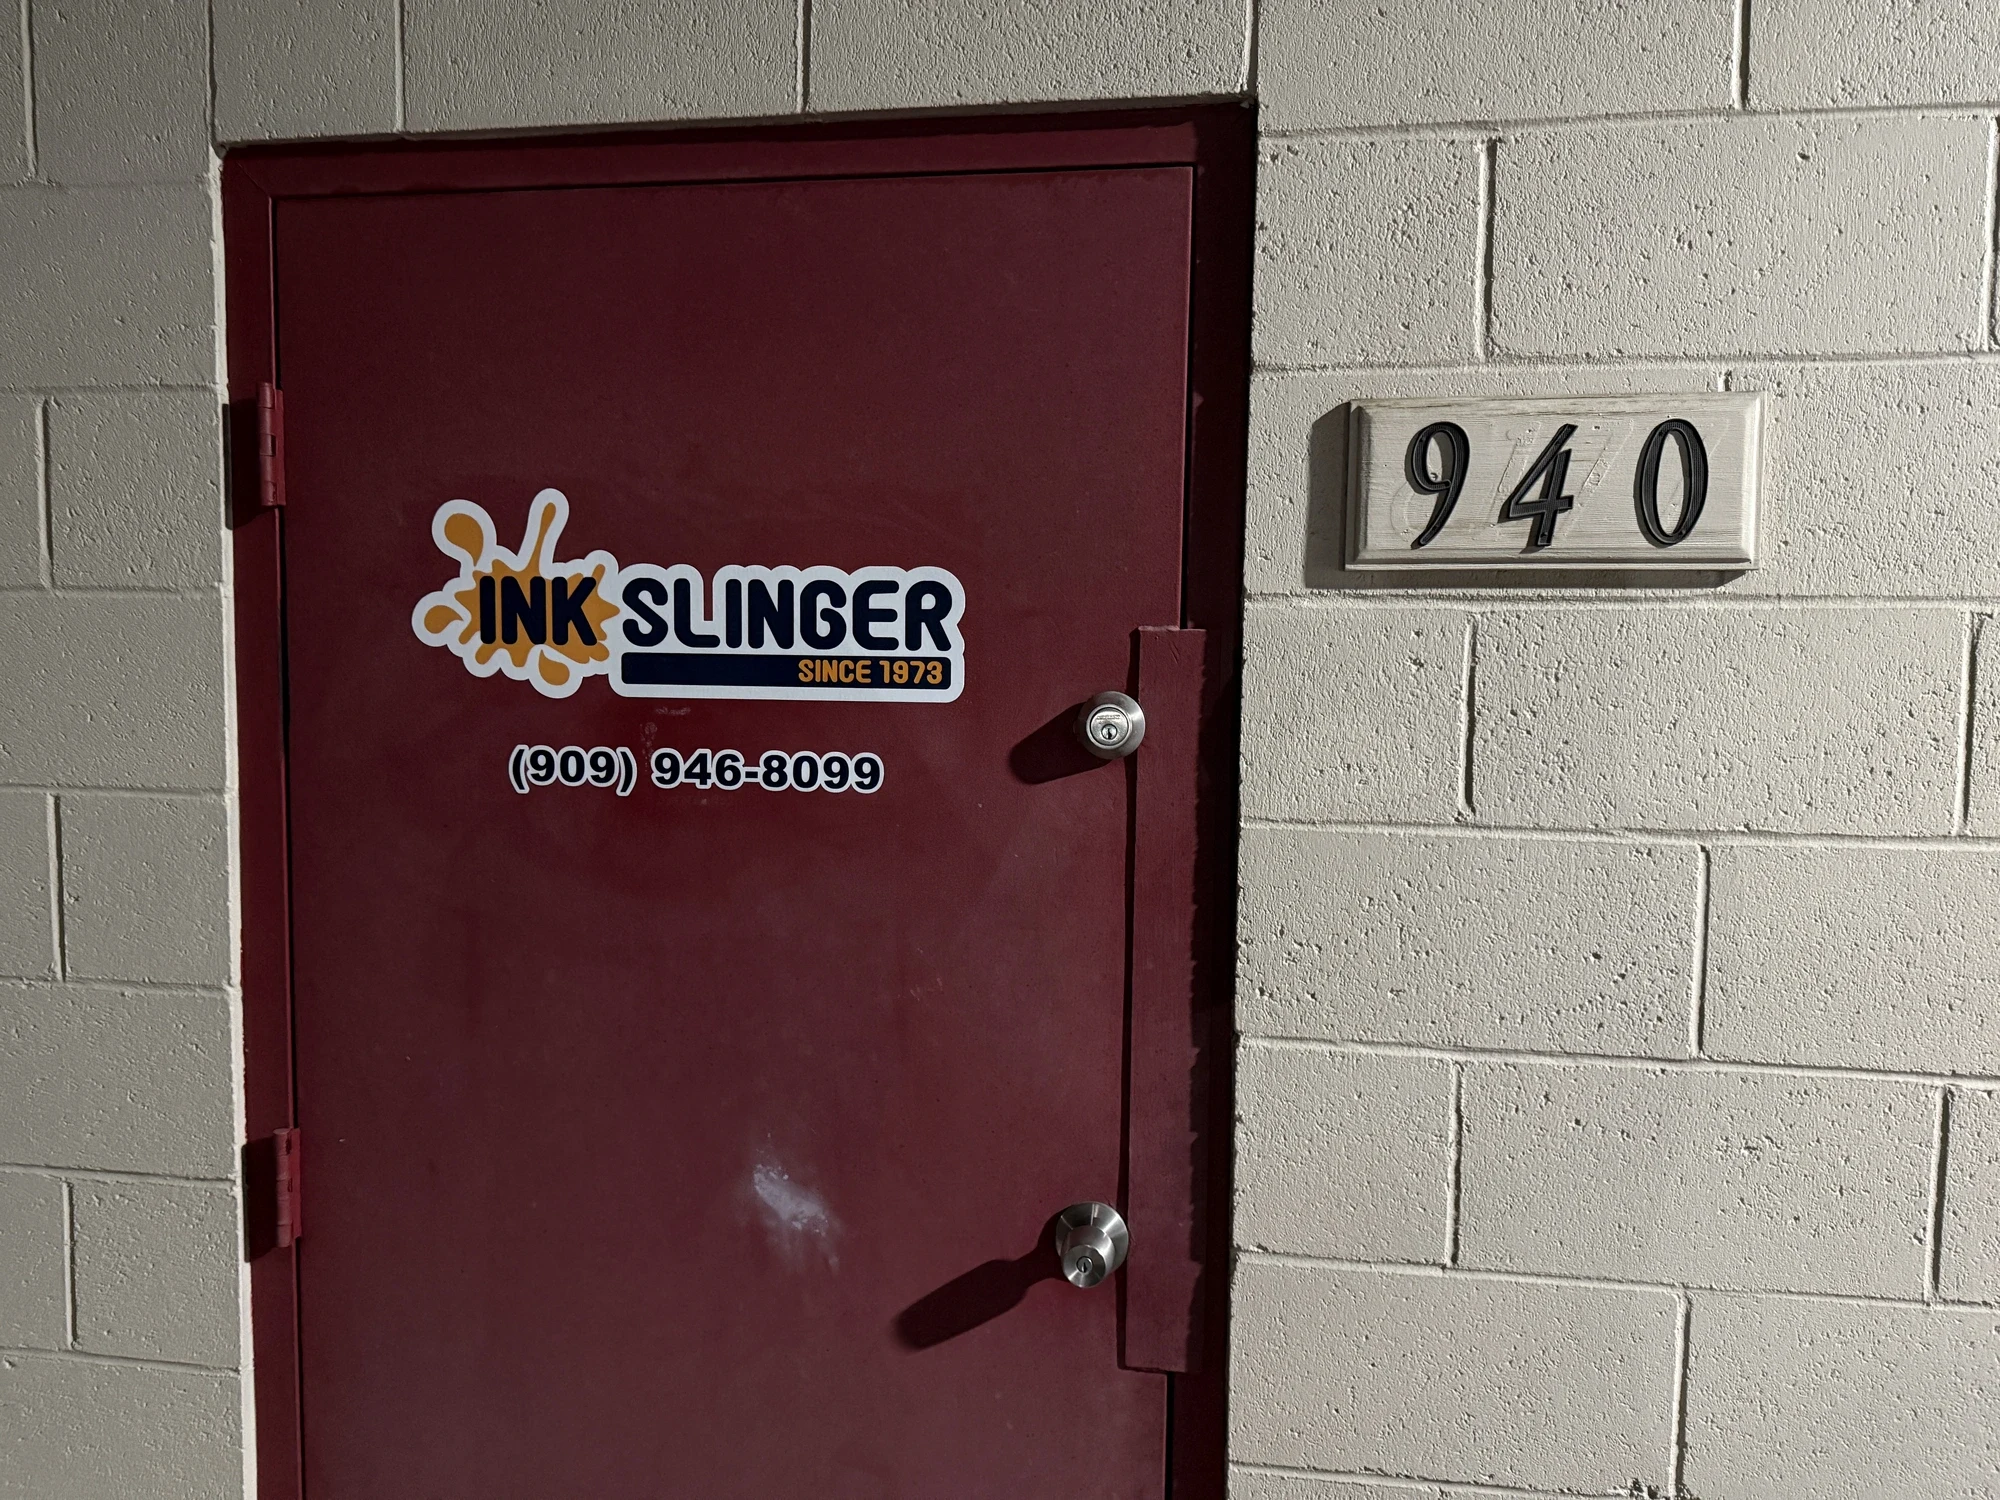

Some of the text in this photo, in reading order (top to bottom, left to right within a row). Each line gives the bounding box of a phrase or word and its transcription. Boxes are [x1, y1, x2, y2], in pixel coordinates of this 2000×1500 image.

[1405, 417, 1709, 549] 940
[479, 575, 953, 652] INK SLINGER
[798, 659, 944, 685] SINCE 1973
[510, 747, 882, 794] (909) 946-8099
